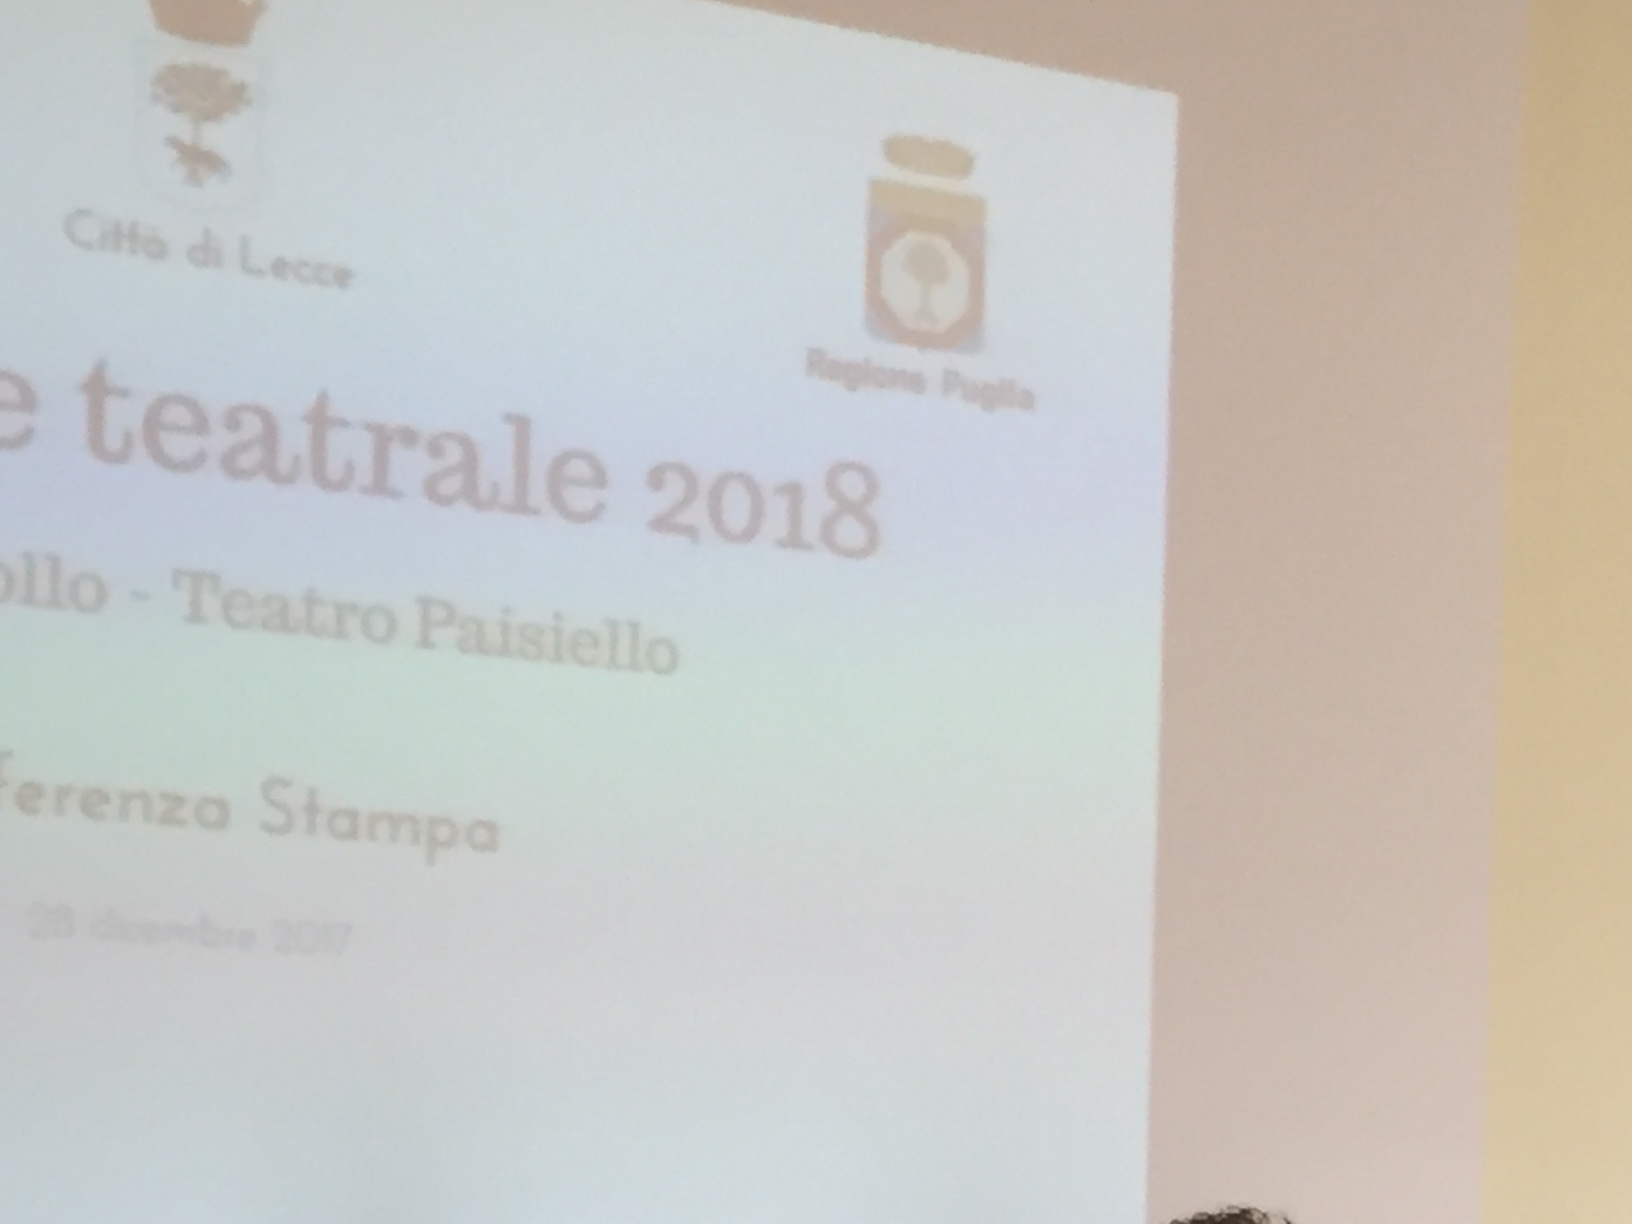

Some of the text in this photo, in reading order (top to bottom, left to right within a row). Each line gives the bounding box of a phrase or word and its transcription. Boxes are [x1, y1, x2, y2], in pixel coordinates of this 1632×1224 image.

[186, 226, 226, 272] di
[240, 236, 356, 291] Lecce
[940, 366, 1036, 412] Puglia
[76, 354, 610, 524] teatrale
[645, 460, 882, 560] 2018
[171, 566, 398, 646] Teatro
[414, 595, 680, 676] Paisiello
[259, 775, 501, 866] Stampa
